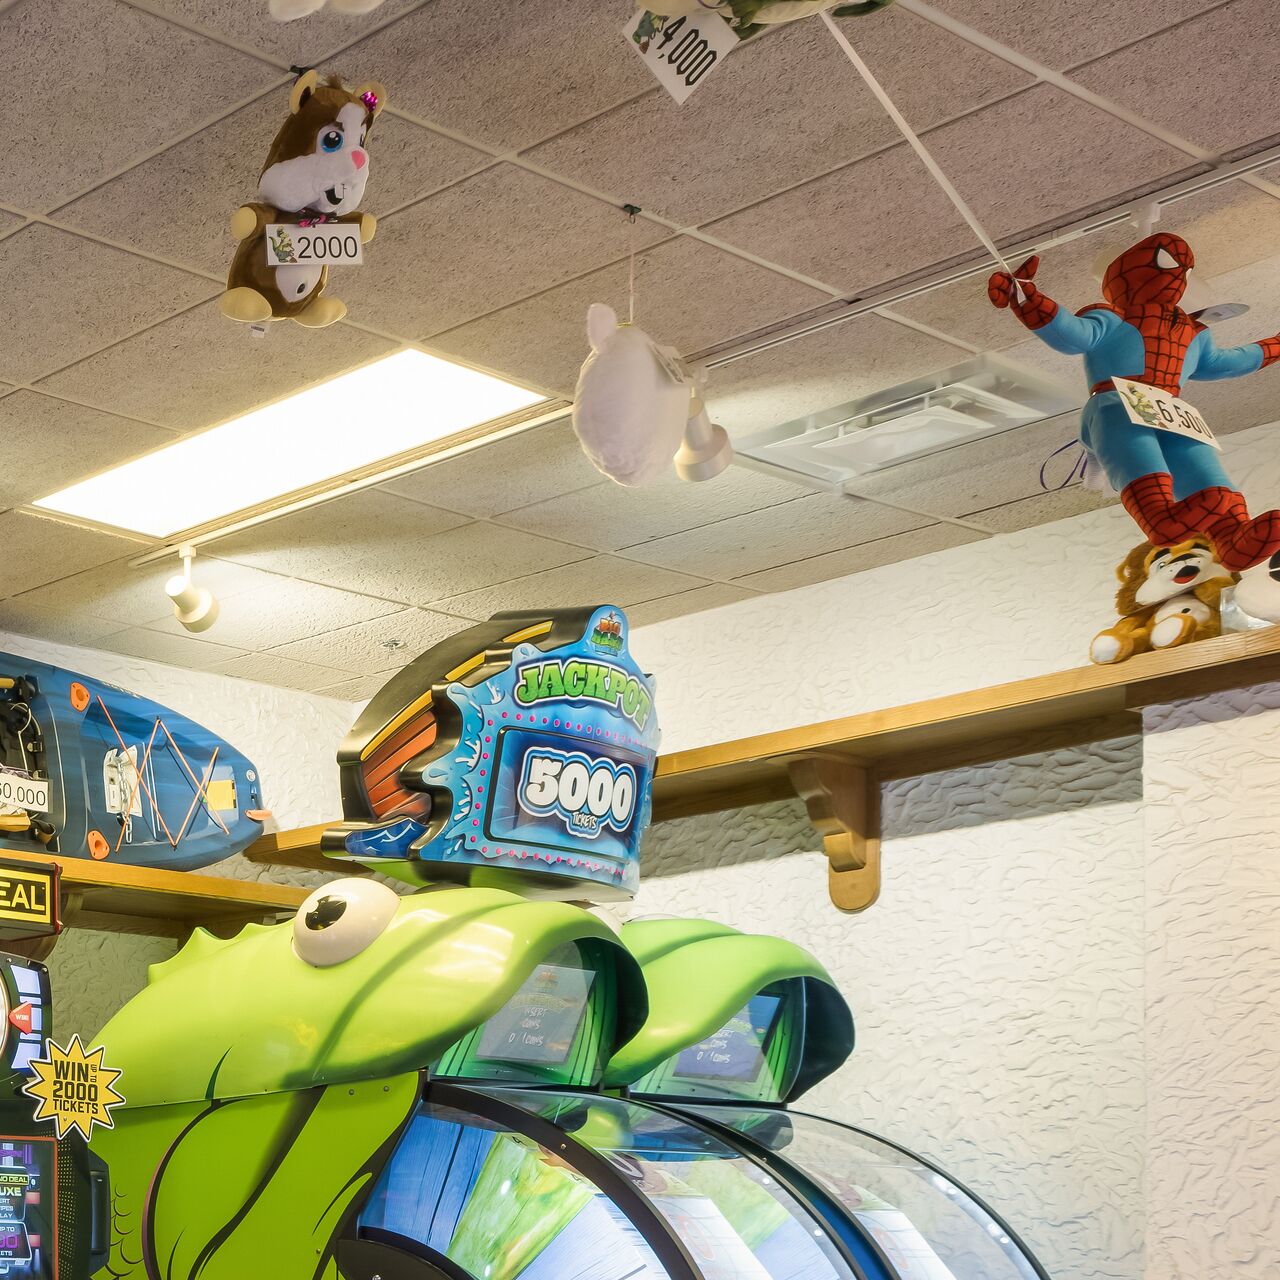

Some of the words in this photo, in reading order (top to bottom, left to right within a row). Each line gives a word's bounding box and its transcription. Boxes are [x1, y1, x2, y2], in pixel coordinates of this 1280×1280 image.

[657, 16, 717, 86] 4,000
[297, 236, 359, 259] 2000
[1155, 399, 1214, 440] 6,500
[515, 660, 653, 733] JACKPOT
[528, 756, 634, 823] 5000
[571, 812, 599, 830] TICKETS
[53, 1059, 90, 1083] WIN
[52, 1079, 99, 1103] 2000
[52, 1098, 99, 1115] TICKETS
